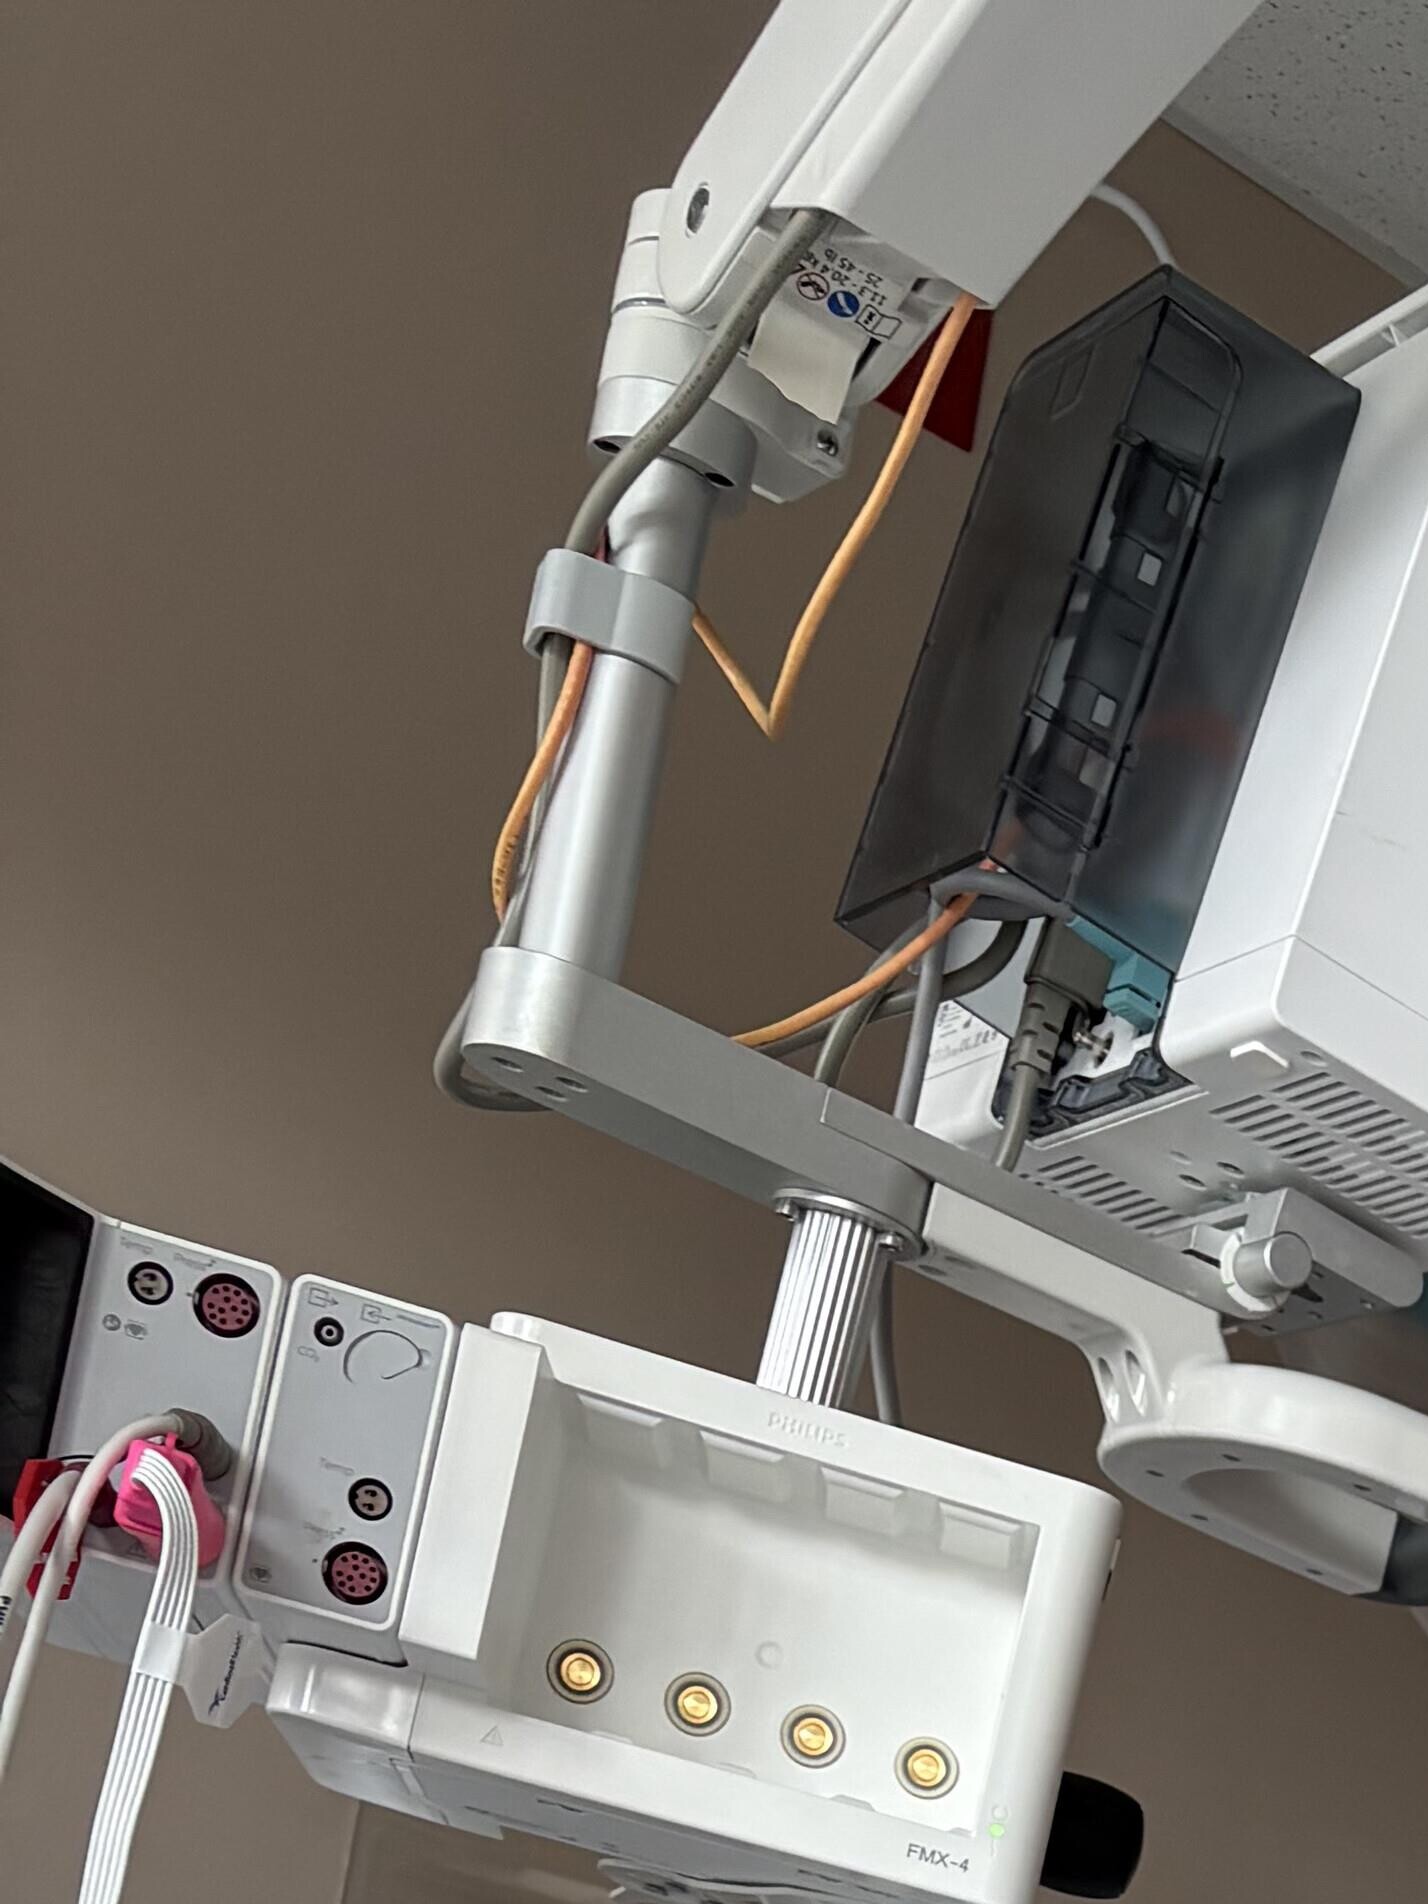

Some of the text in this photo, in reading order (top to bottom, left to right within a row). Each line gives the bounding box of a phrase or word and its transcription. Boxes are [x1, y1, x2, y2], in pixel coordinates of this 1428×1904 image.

[839, 257, 856, 272] 45
[820, 265, 850, 286] 20.4
[865, 273, 883, 288] 25
[857, 287, 887, 306] 11.3
[906, 1842, 970, 1873] FMX-4
